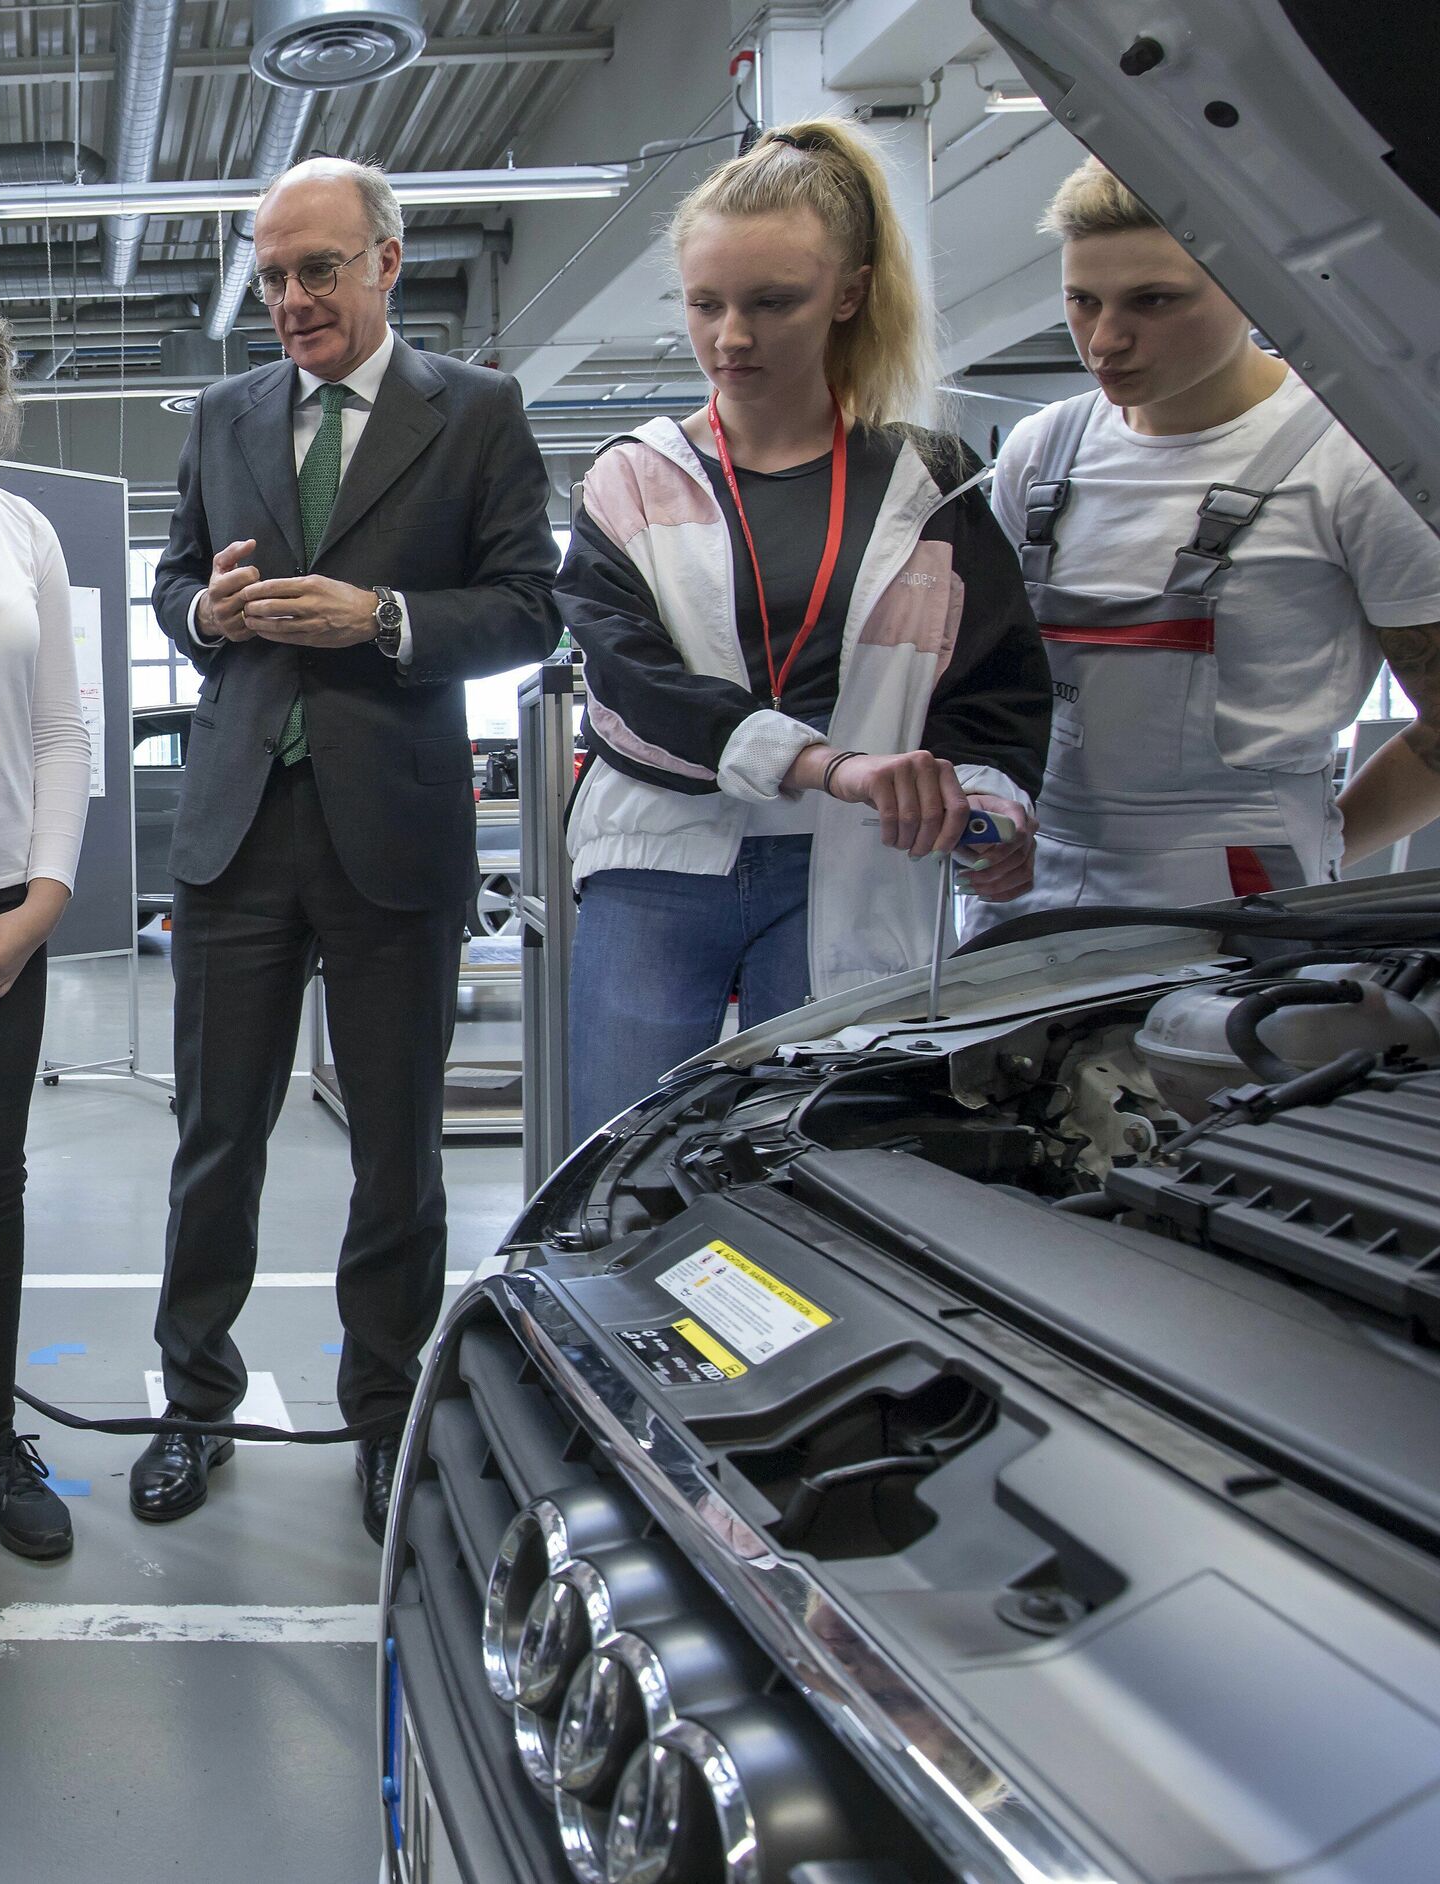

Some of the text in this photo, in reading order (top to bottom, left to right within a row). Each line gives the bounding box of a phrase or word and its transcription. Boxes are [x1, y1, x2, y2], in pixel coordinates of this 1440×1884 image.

[723, 1252, 815, 1317] ACHTUNG WARNING ATTENTION
